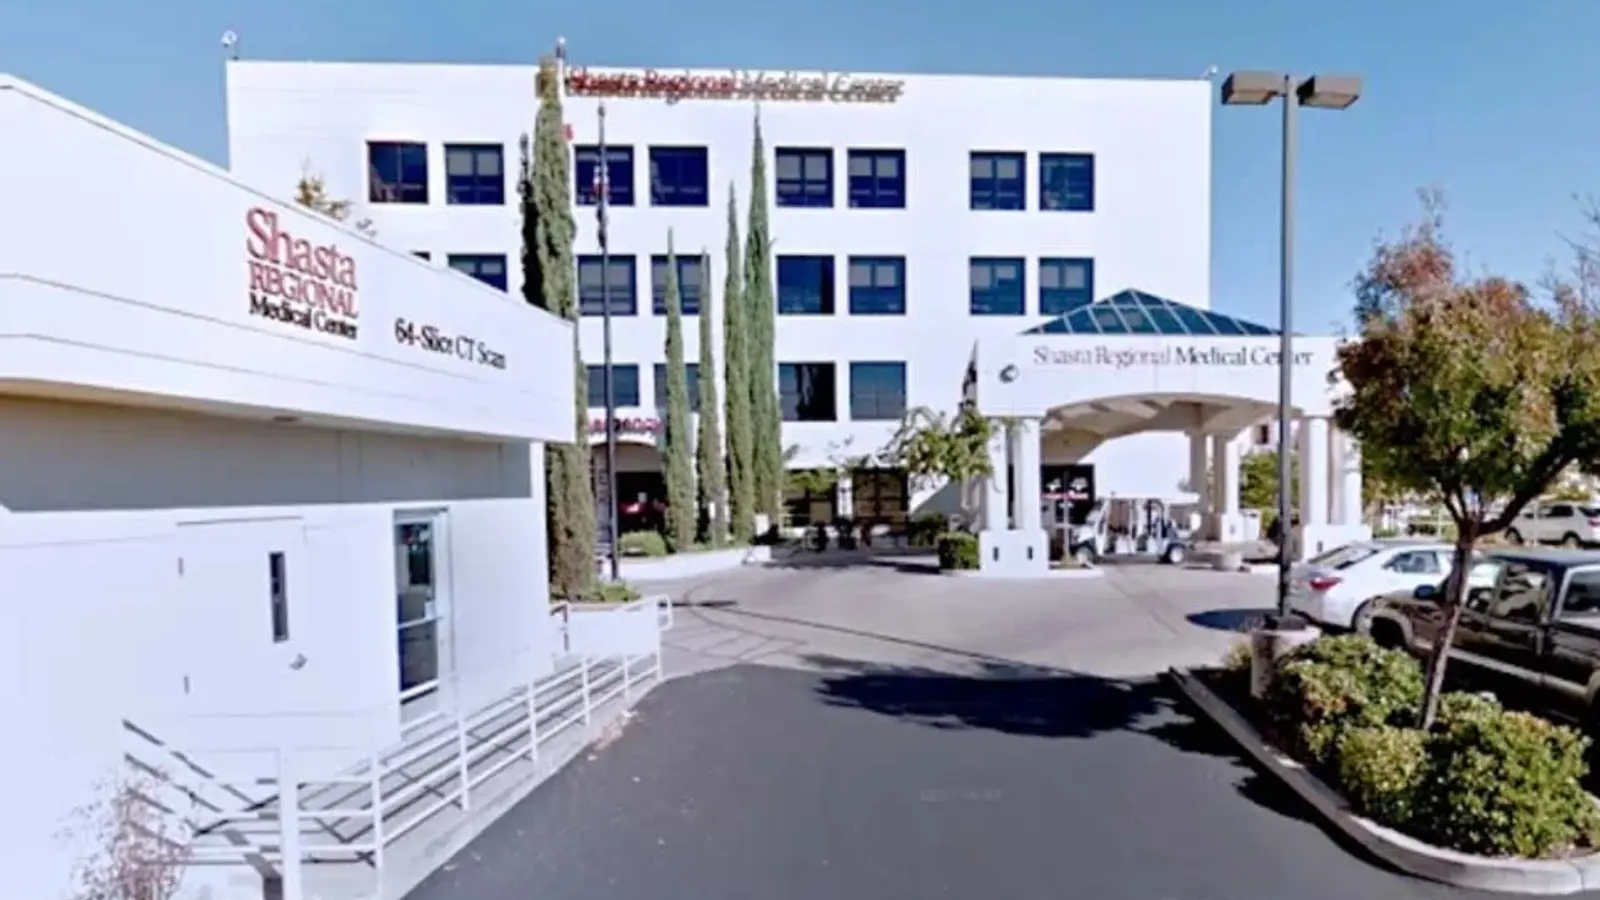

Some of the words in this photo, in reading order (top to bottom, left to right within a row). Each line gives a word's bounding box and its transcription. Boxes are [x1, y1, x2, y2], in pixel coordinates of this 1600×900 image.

[566, 66, 640, 97] Shasta
[246, 207, 357, 290] Shasta
[248, 259, 359, 319] REGIONAL
[249, 292, 312, 329] Medical
[314, 310, 358, 340] Center
[456, 335, 475, 362] CT
[477, 341, 506, 369] Scan
[1175, 346, 1247, 366] Medical
[1250, 345, 1314, 366] Cener
